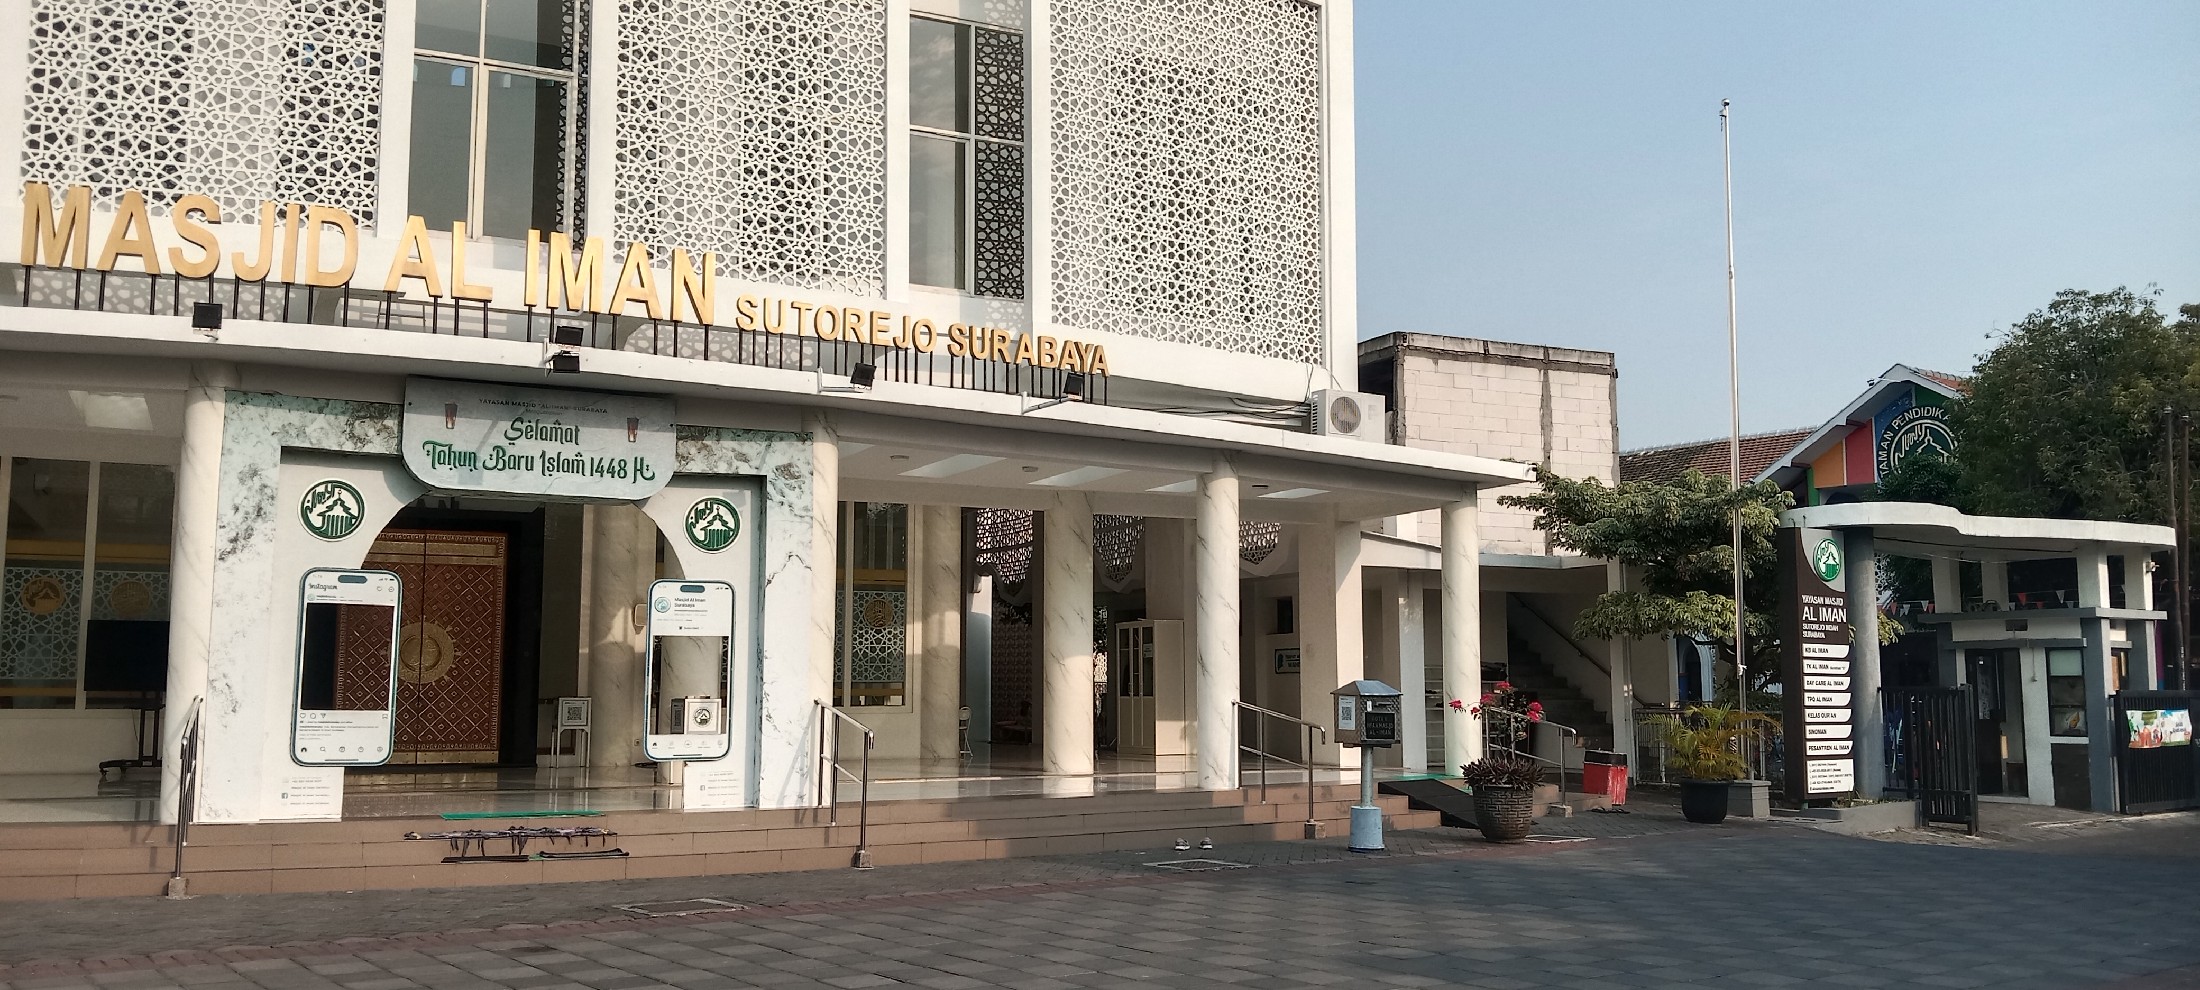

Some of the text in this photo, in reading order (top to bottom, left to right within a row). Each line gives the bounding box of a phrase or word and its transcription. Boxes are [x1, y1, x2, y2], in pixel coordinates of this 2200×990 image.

[21, 182, 1110, 377] MASJID AL IMAN SUTOREJO SURABAYA
[504, 416, 581, 446] Selamat
[422, 440, 479, 473] Tahun
[482, 445, 535, 472] Baru
[540, 450, 586, 477] Islam
[590, 456, 628, 479] 1448
[1878, 431, 1894, 478] TAMAN
[1801, 594, 1844, 606] YAYASAN MASJID
[1802, 606, 1847, 622] AL IMAN
